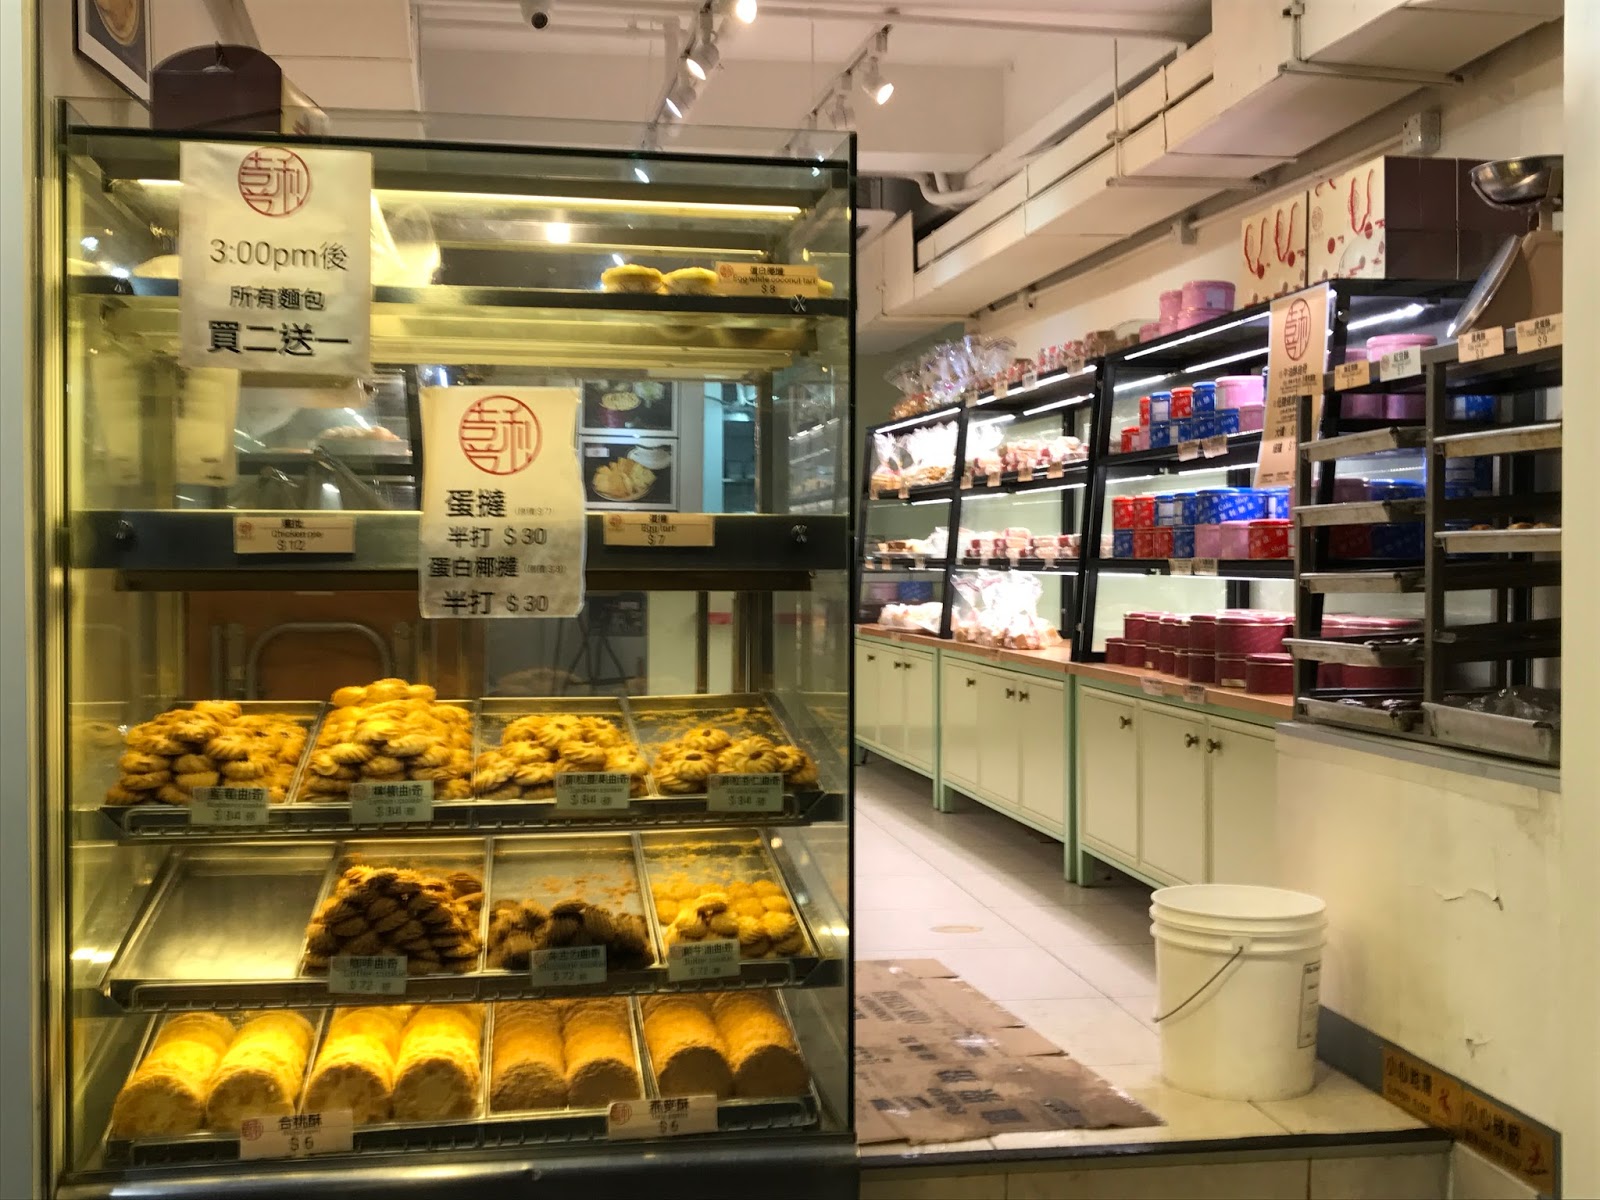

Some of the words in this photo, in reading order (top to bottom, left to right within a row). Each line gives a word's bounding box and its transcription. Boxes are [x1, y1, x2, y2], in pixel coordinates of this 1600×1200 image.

[210, 239, 349, 271] 3:00pm後
[229, 285, 326, 311] 所有麵包
[207, 320, 351, 356] 買二送一
[447, 527, 493, 548] 半打
[442, 590, 495, 615] 半打
